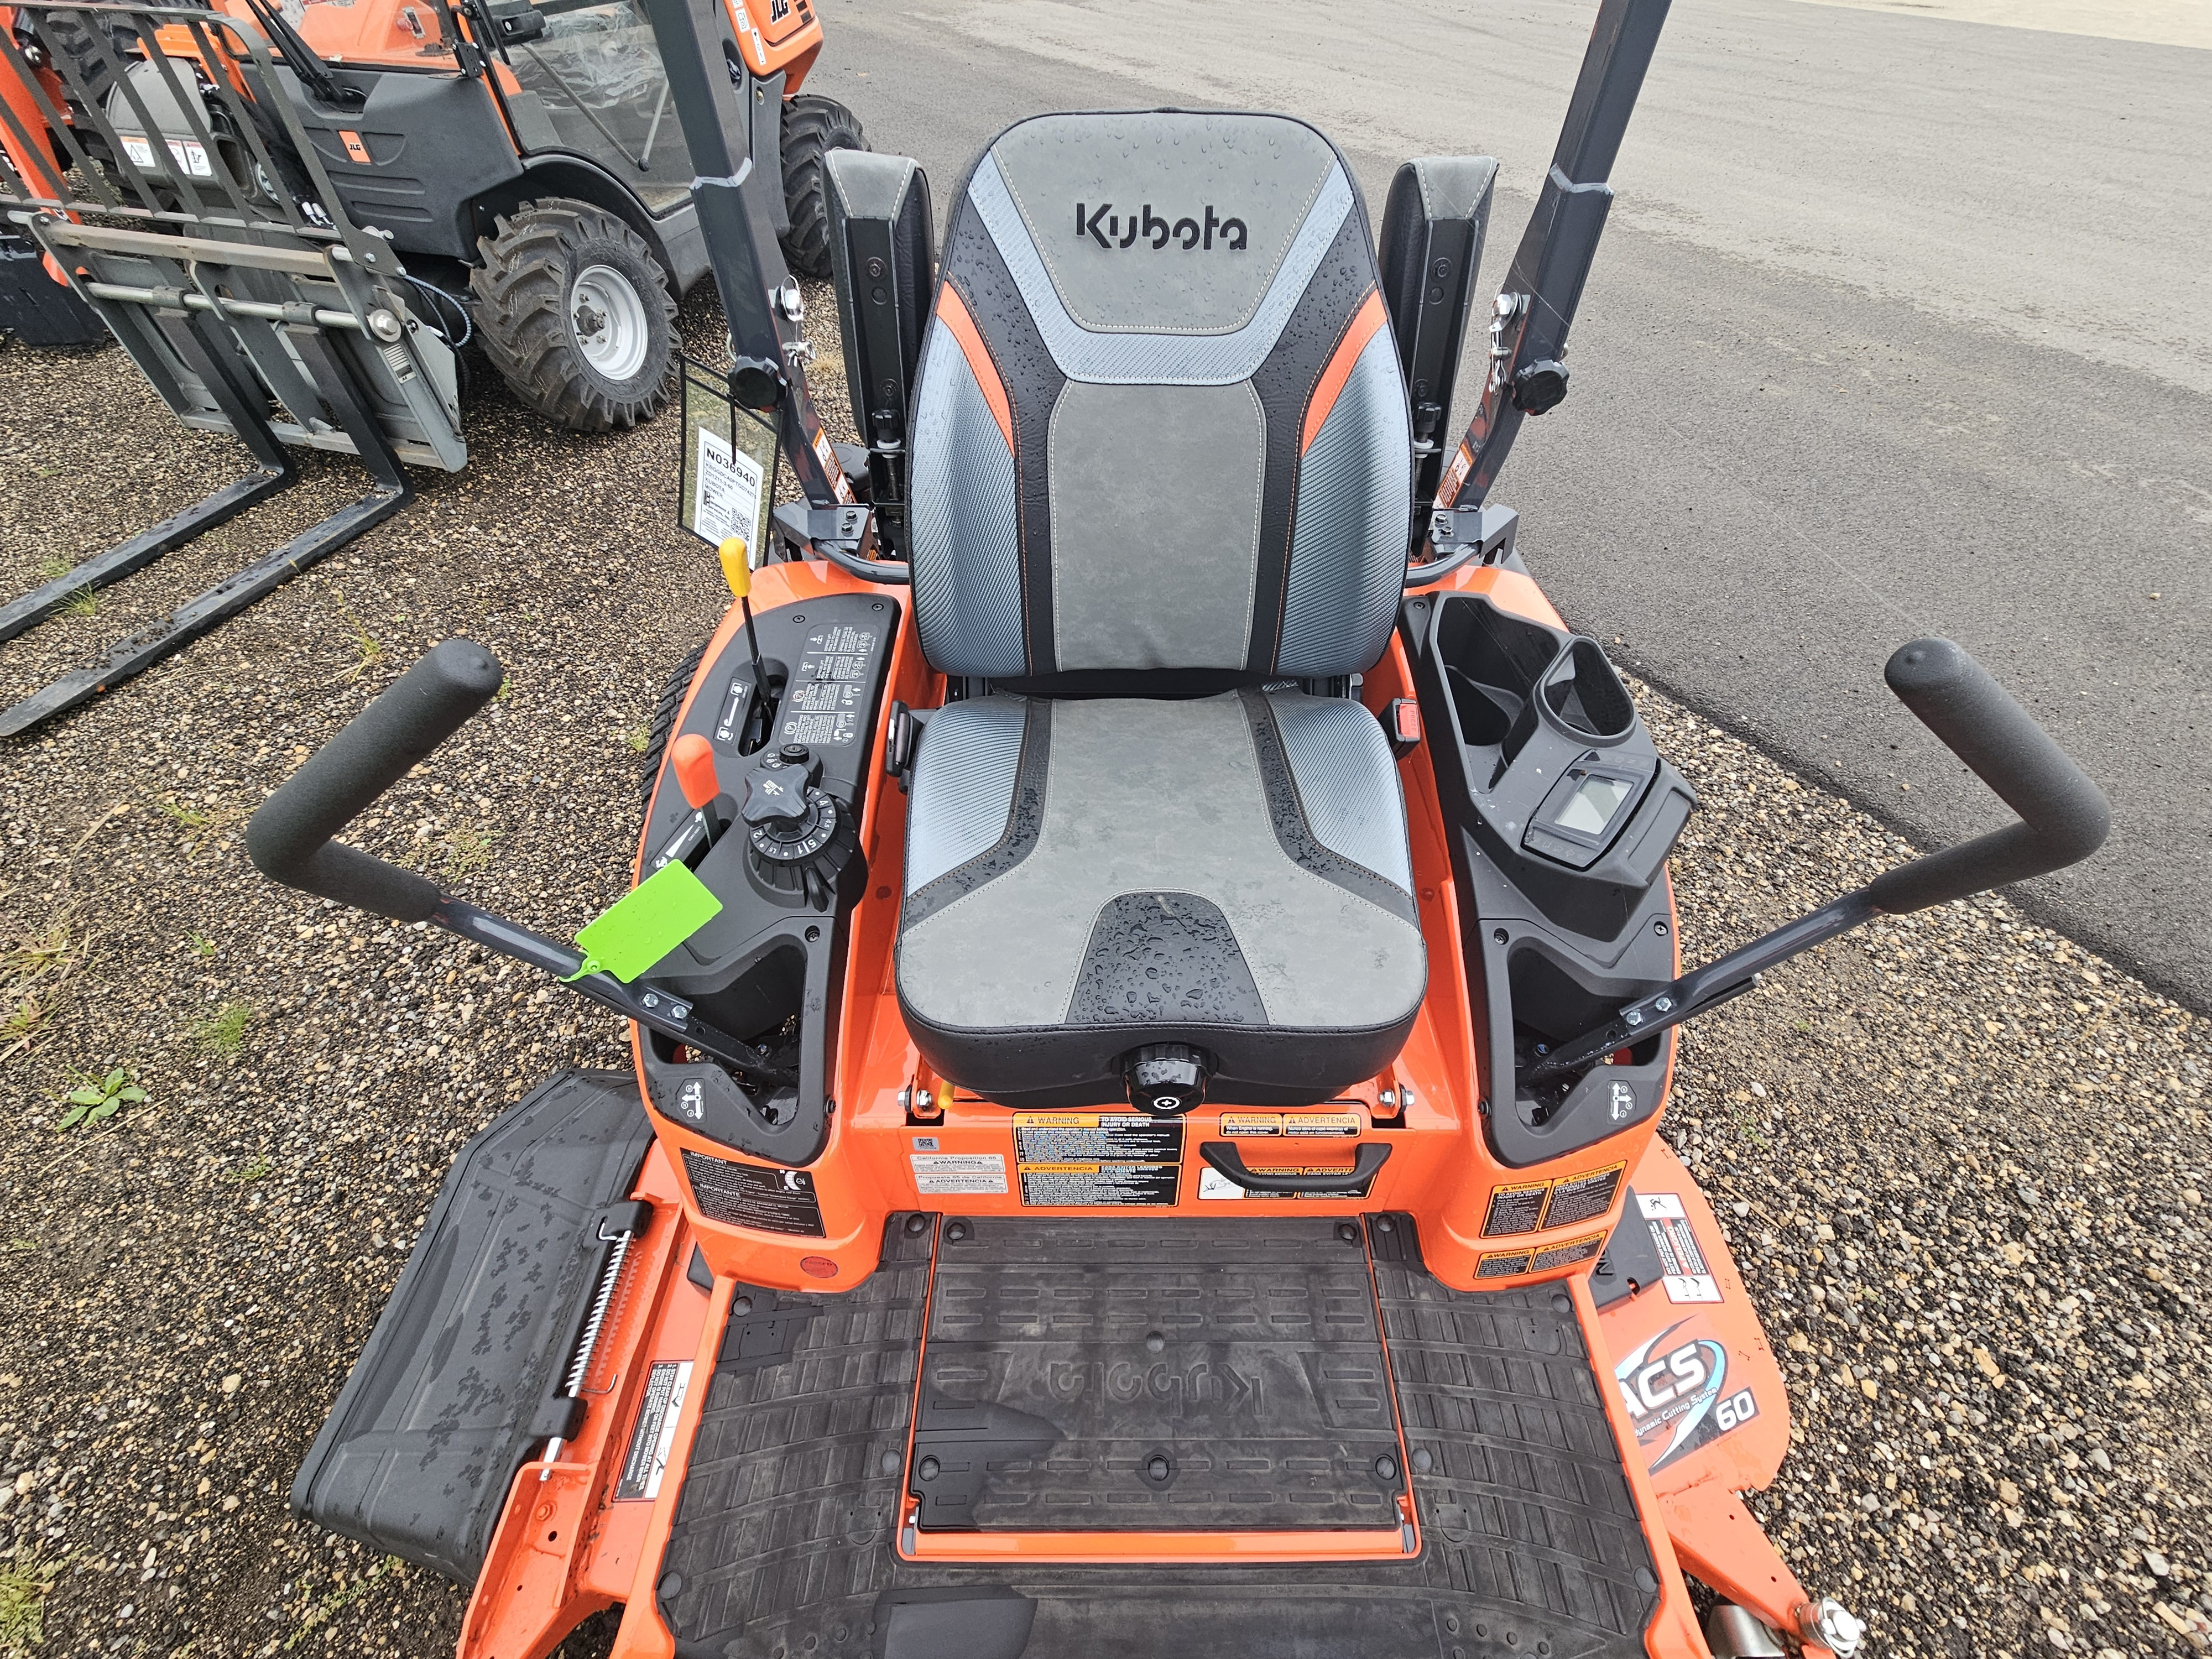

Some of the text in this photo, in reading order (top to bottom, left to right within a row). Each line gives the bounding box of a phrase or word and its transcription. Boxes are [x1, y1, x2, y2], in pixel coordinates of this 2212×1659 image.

[1076, 203, 1248, 249] Kubota
[706, 447, 755, 487] N036940
[705, 477, 724, 492] KUBOTA
[705, 483, 723, 498] MOWER
[808, 839, 817, 848] 5
[690, 1151, 728, 1165] IMPORTANT
[1572, 1165, 1618, 1181] ADVERTENCIA
[698, 1183, 740, 1197] IMPORTANTE
[1550, 1234, 1600, 1250] ADVERTENCIA
[1652, 1233, 1661, 1248] HANDS
[1657, 1235, 1667, 1251] MOWER
[1666, 1225, 1686, 1260] PELIGRO
[658, 1369, 666, 1386] ENGINE
[664, 1381, 672, 1396] CLEAR
[646, 1387, 656, 1408] OPERATE
[655, 1396, 663, 1412] HANDS
[641, 1409, 650, 1427] MOWER
[654, 1405, 666, 1432] DISCHARGE
[1635, 1387, 1718, 1437] dynamic Cutting System
[1715, 1392, 1756, 1432] 60
[648, 1433, 658, 1454] OPENING
[640, 1447, 649, 1465] MOWER
[626, 1451, 639, 1480] DISCHARGE
[635, 1467, 644, 1481] WHEN
